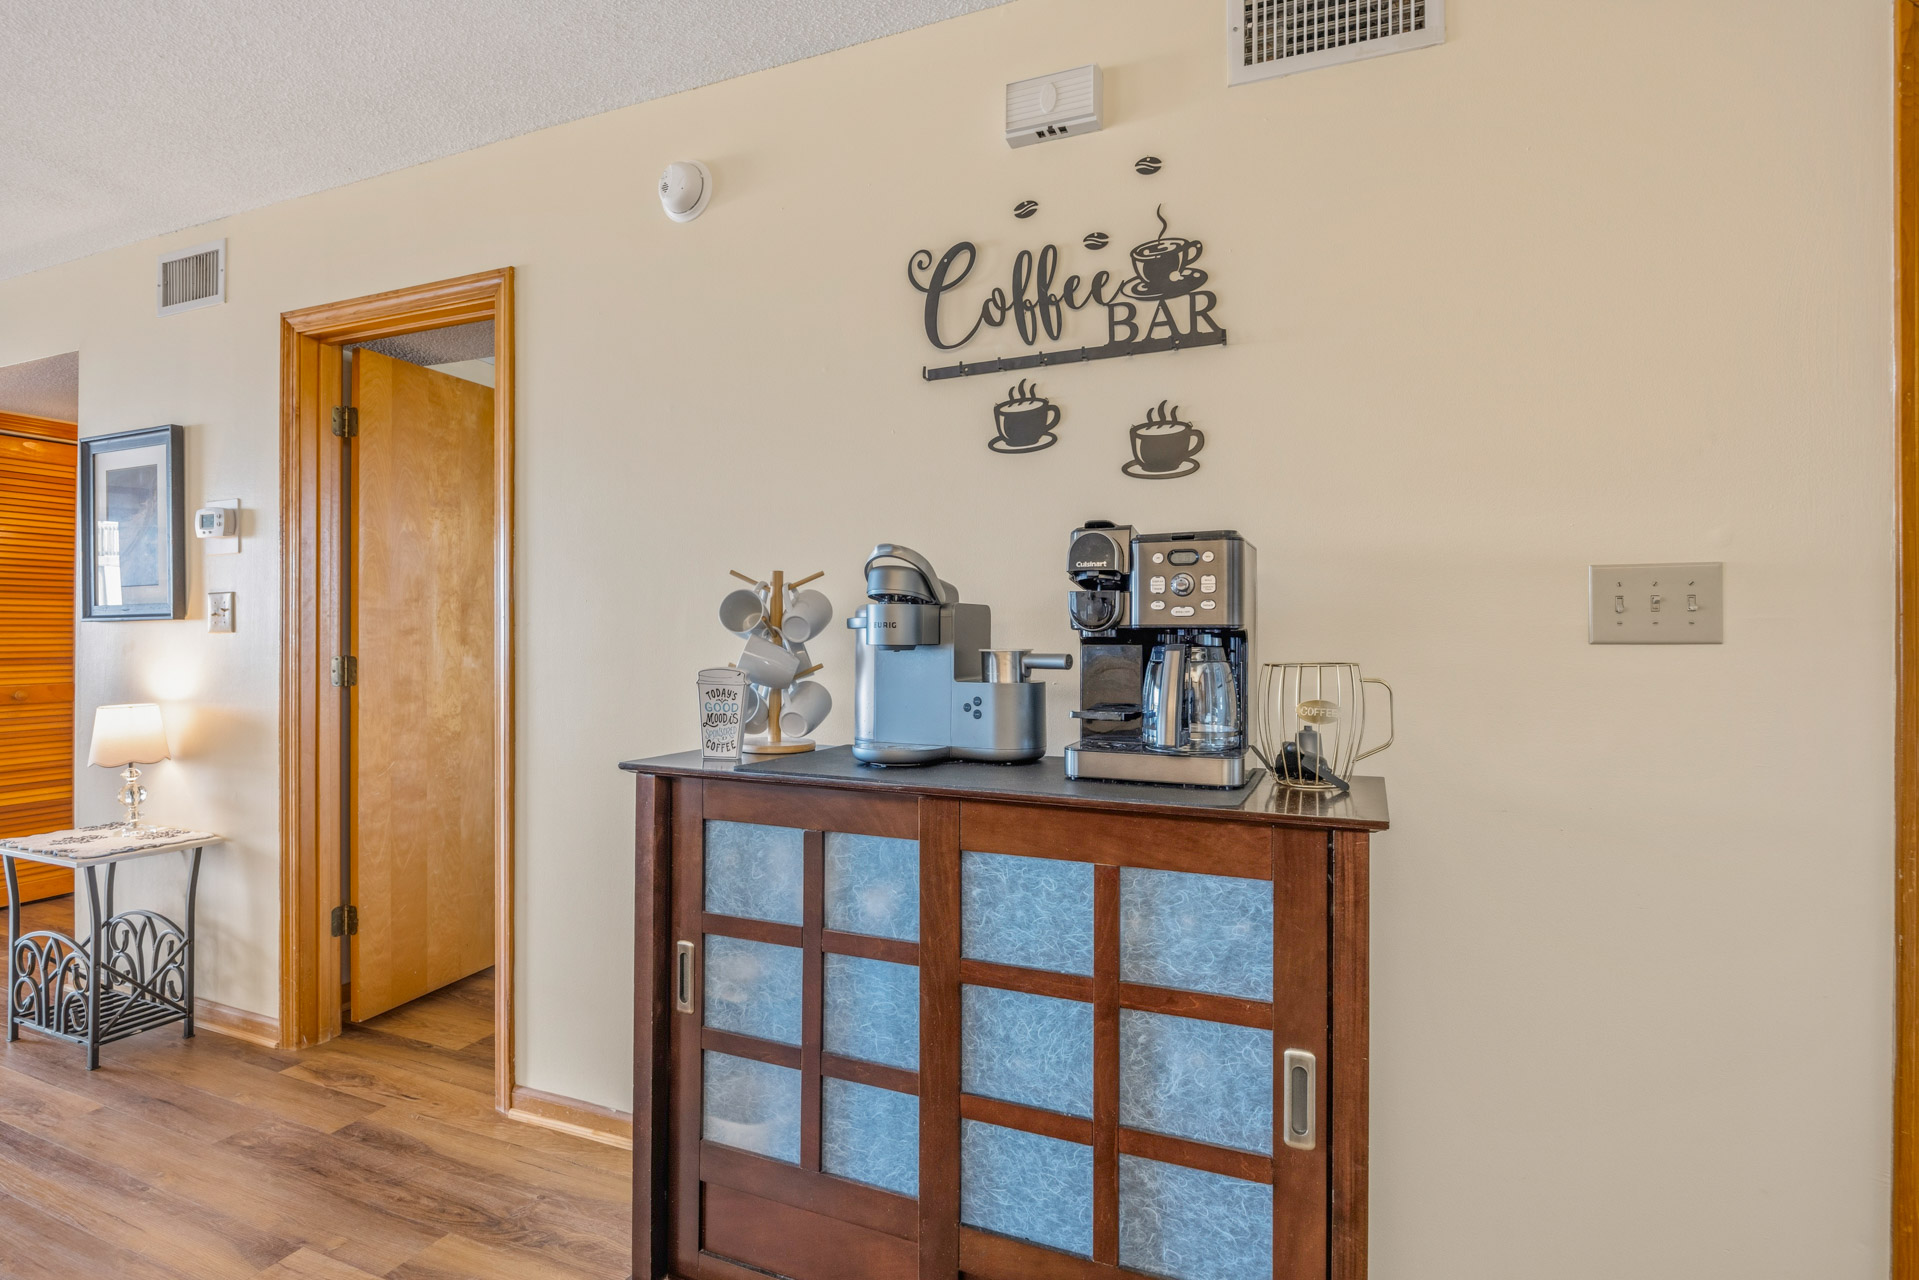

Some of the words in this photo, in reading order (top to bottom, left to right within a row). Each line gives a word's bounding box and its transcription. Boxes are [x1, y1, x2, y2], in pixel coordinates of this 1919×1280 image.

[908, 241, 1125, 350] Coffee
[1102, 290, 1223, 347] BAR
[705, 688, 738, 700] TODAY'S
[705, 702, 738, 712] GOOD
[1300, 706, 1338, 718] COFFEE
[703, 713, 727, 727] MOOD
[706, 739, 736, 752] COFFEE
